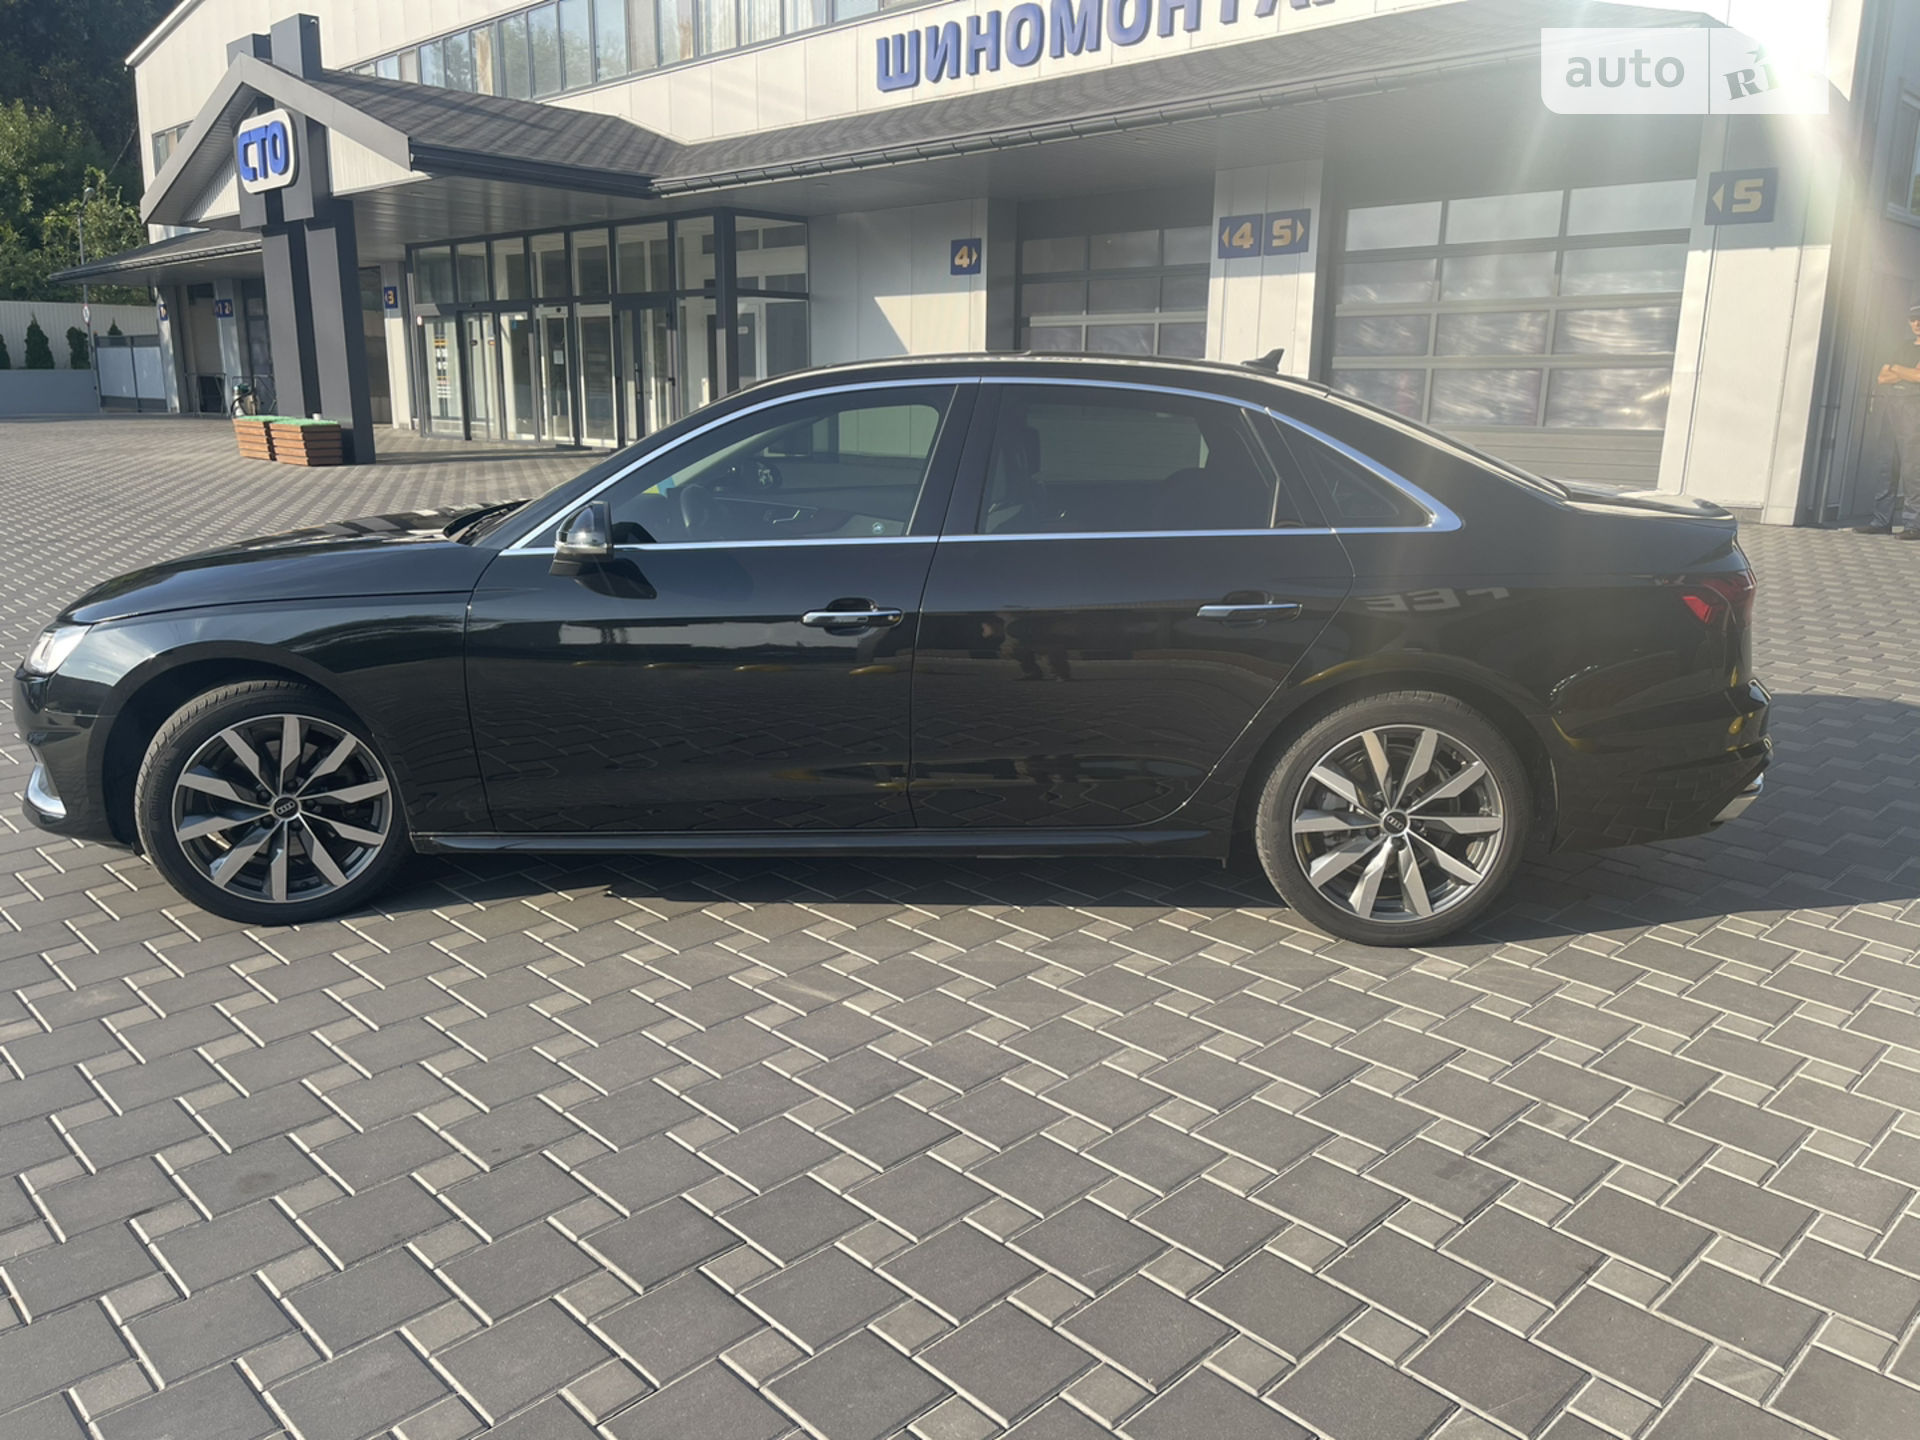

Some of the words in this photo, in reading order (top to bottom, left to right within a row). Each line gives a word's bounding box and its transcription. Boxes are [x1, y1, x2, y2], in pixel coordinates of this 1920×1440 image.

[876, 0, 1336, 92] ШИНОМОН
[237, 120, 290, 182] СТО
[954, 245, 970, 268] 4
[1232, 221, 1254, 249] 4
